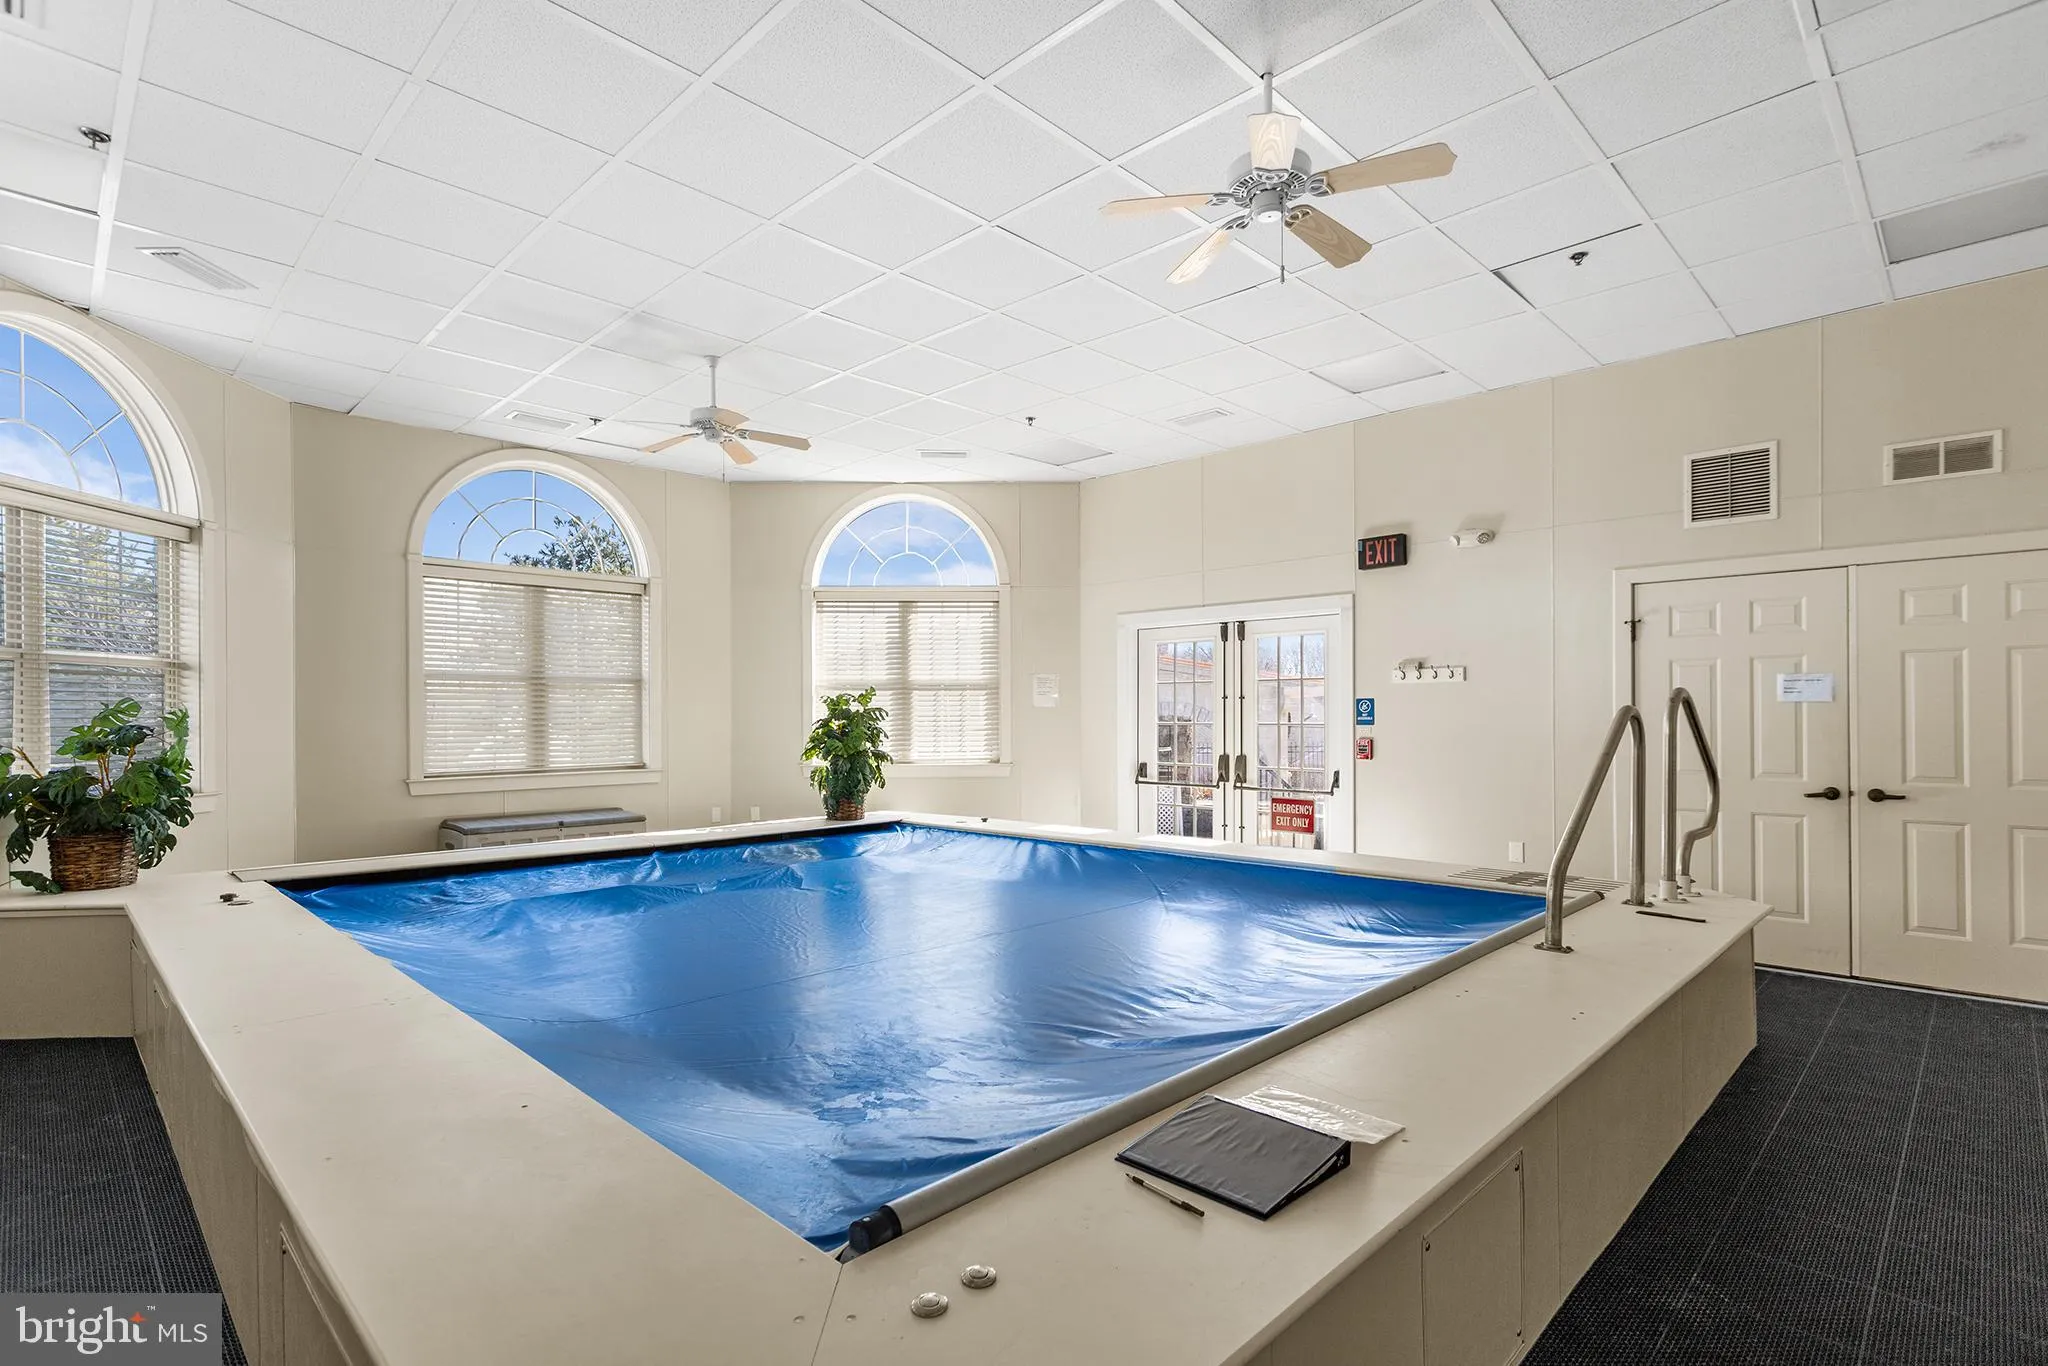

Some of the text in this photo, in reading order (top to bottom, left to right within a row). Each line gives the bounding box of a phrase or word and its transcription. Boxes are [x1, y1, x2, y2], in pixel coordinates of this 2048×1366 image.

[1365, 538, 1397, 565] EXIT
[1273, 803, 1313, 815] EMERGENCY
[1276, 816, 1309, 828] EXIT ONLY
